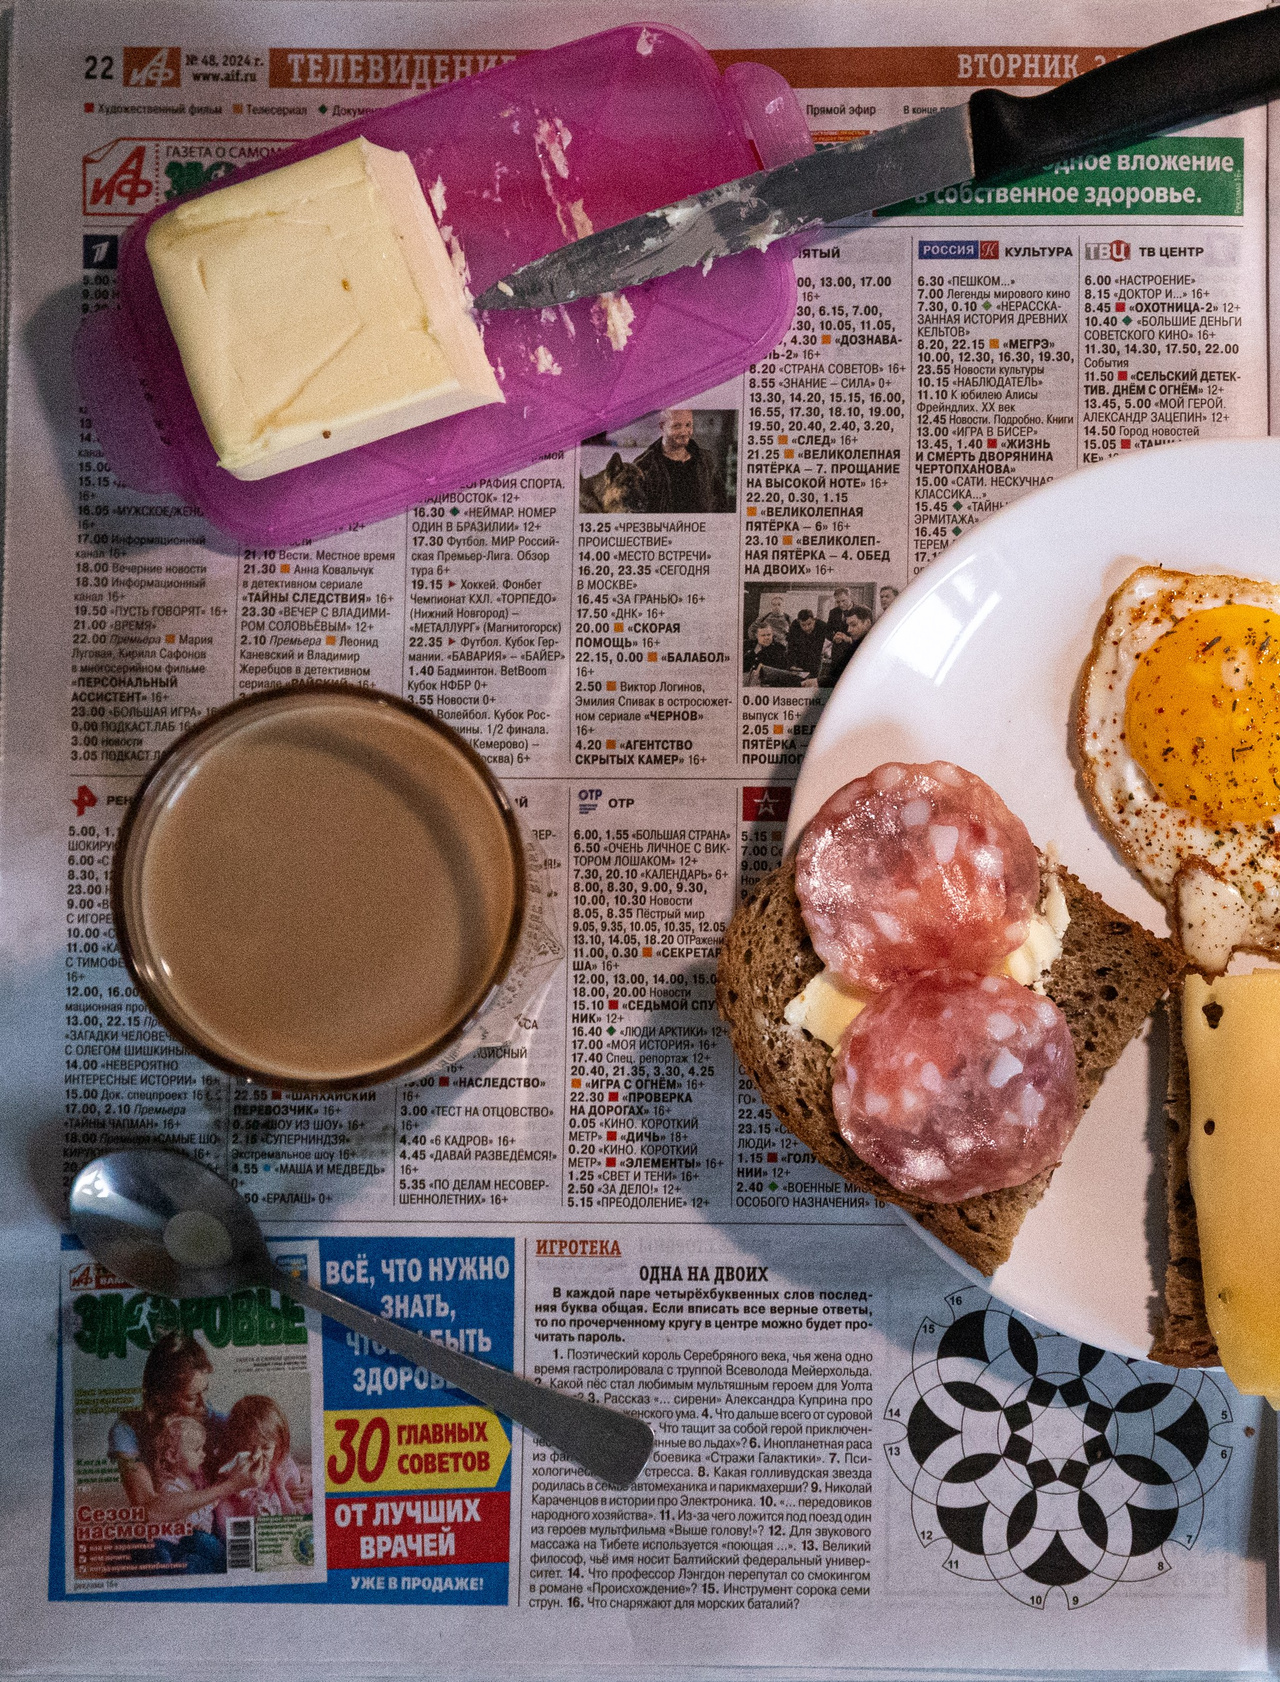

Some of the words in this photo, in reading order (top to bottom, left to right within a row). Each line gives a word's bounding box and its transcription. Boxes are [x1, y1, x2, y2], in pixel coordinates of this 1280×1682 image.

[85, 56, 113, 79] 22
[202, 55, 218, 66] 48,
[223, 55, 250, 66] 2024
[254, 58, 264, 67] г.
[192, 70, 256, 82] www.aif.ru
[806, 104, 845, 117] Прямой
[848, 104, 877, 117] эфир
[1118, 155, 1233, 172] вложение
[1085, 187, 1201, 208] здоровье.
[924, 245, 974, 254] РОССИЯ
[1005, 247, 1072, 257] КУЛЬТУРА
[1140, 247, 1155, 256] ТВ
[1160, 247, 1203, 258] ЦЕНТР
[1085, 275, 1111, 285] 6.00
[1115, 275, 1195, 285] «НАСТРОЕНИЕ»
[918, 289, 943, 299] 7.00
[947, 289, 990, 300] Легенды
[994, 291, 1043, 300] мирового
[1085, 303, 1111, 313] 8.45
[1130, 302, 1217, 314] «ОХОТНИЦА-2»
[747, 479, 761, 487] НА
[766, 477, 825, 488] ВЫСОКОЙ
[830, 478, 865, 488] НОТЕ»
[77, 562, 108, 573] 18.00
[112, 562, 162, 574] Вечерние
[166, 566, 206, 574] новости
[411, 622, 480, 633] «МЕТАЛЛУРГ»
[483, 622, 561, 634] (Магнитогорск)
[608, 798, 634, 808] ОТР
[537, 1240, 621, 1257] ИГРОТЕКА
[326, 1254, 375, 1288] ВСЁ,
[382, 1258, 422, 1282] ЧТО
[429, 1256, 509, 1281] НУЖНО
[640, 1266, 682, 1284] ОДНА
[688, 1267, 709, 1281] НА
[714, 1266, 768, 1284] ДВОИХ
[381, 1294, 456, 1322] ЗНАТЬ,
[578, 1333, 625, 1344] пароль.
[397, 1422, 487, 1445] ГЛАВНЫХ
[327, 1417, 390, 1484] 30
[398, 1451, 490, 1474] СОВЕТОВ
[77, 1506, 144, 1523] Сезон
[335, 1504, 367, 1527] ОТ
[373, 1499, 480, 1525] ЛУЧШИХ
[77, 1523, 192, 1543] насморка:
[360, 1527, 455, 1559] ВРАЧЕЙ
[352, 1577, 384, 1589] УЖЕ
[389, 1577, 397, 1589] В
[401, 1577, 483, 1592] ПРОДАЖЕ!
